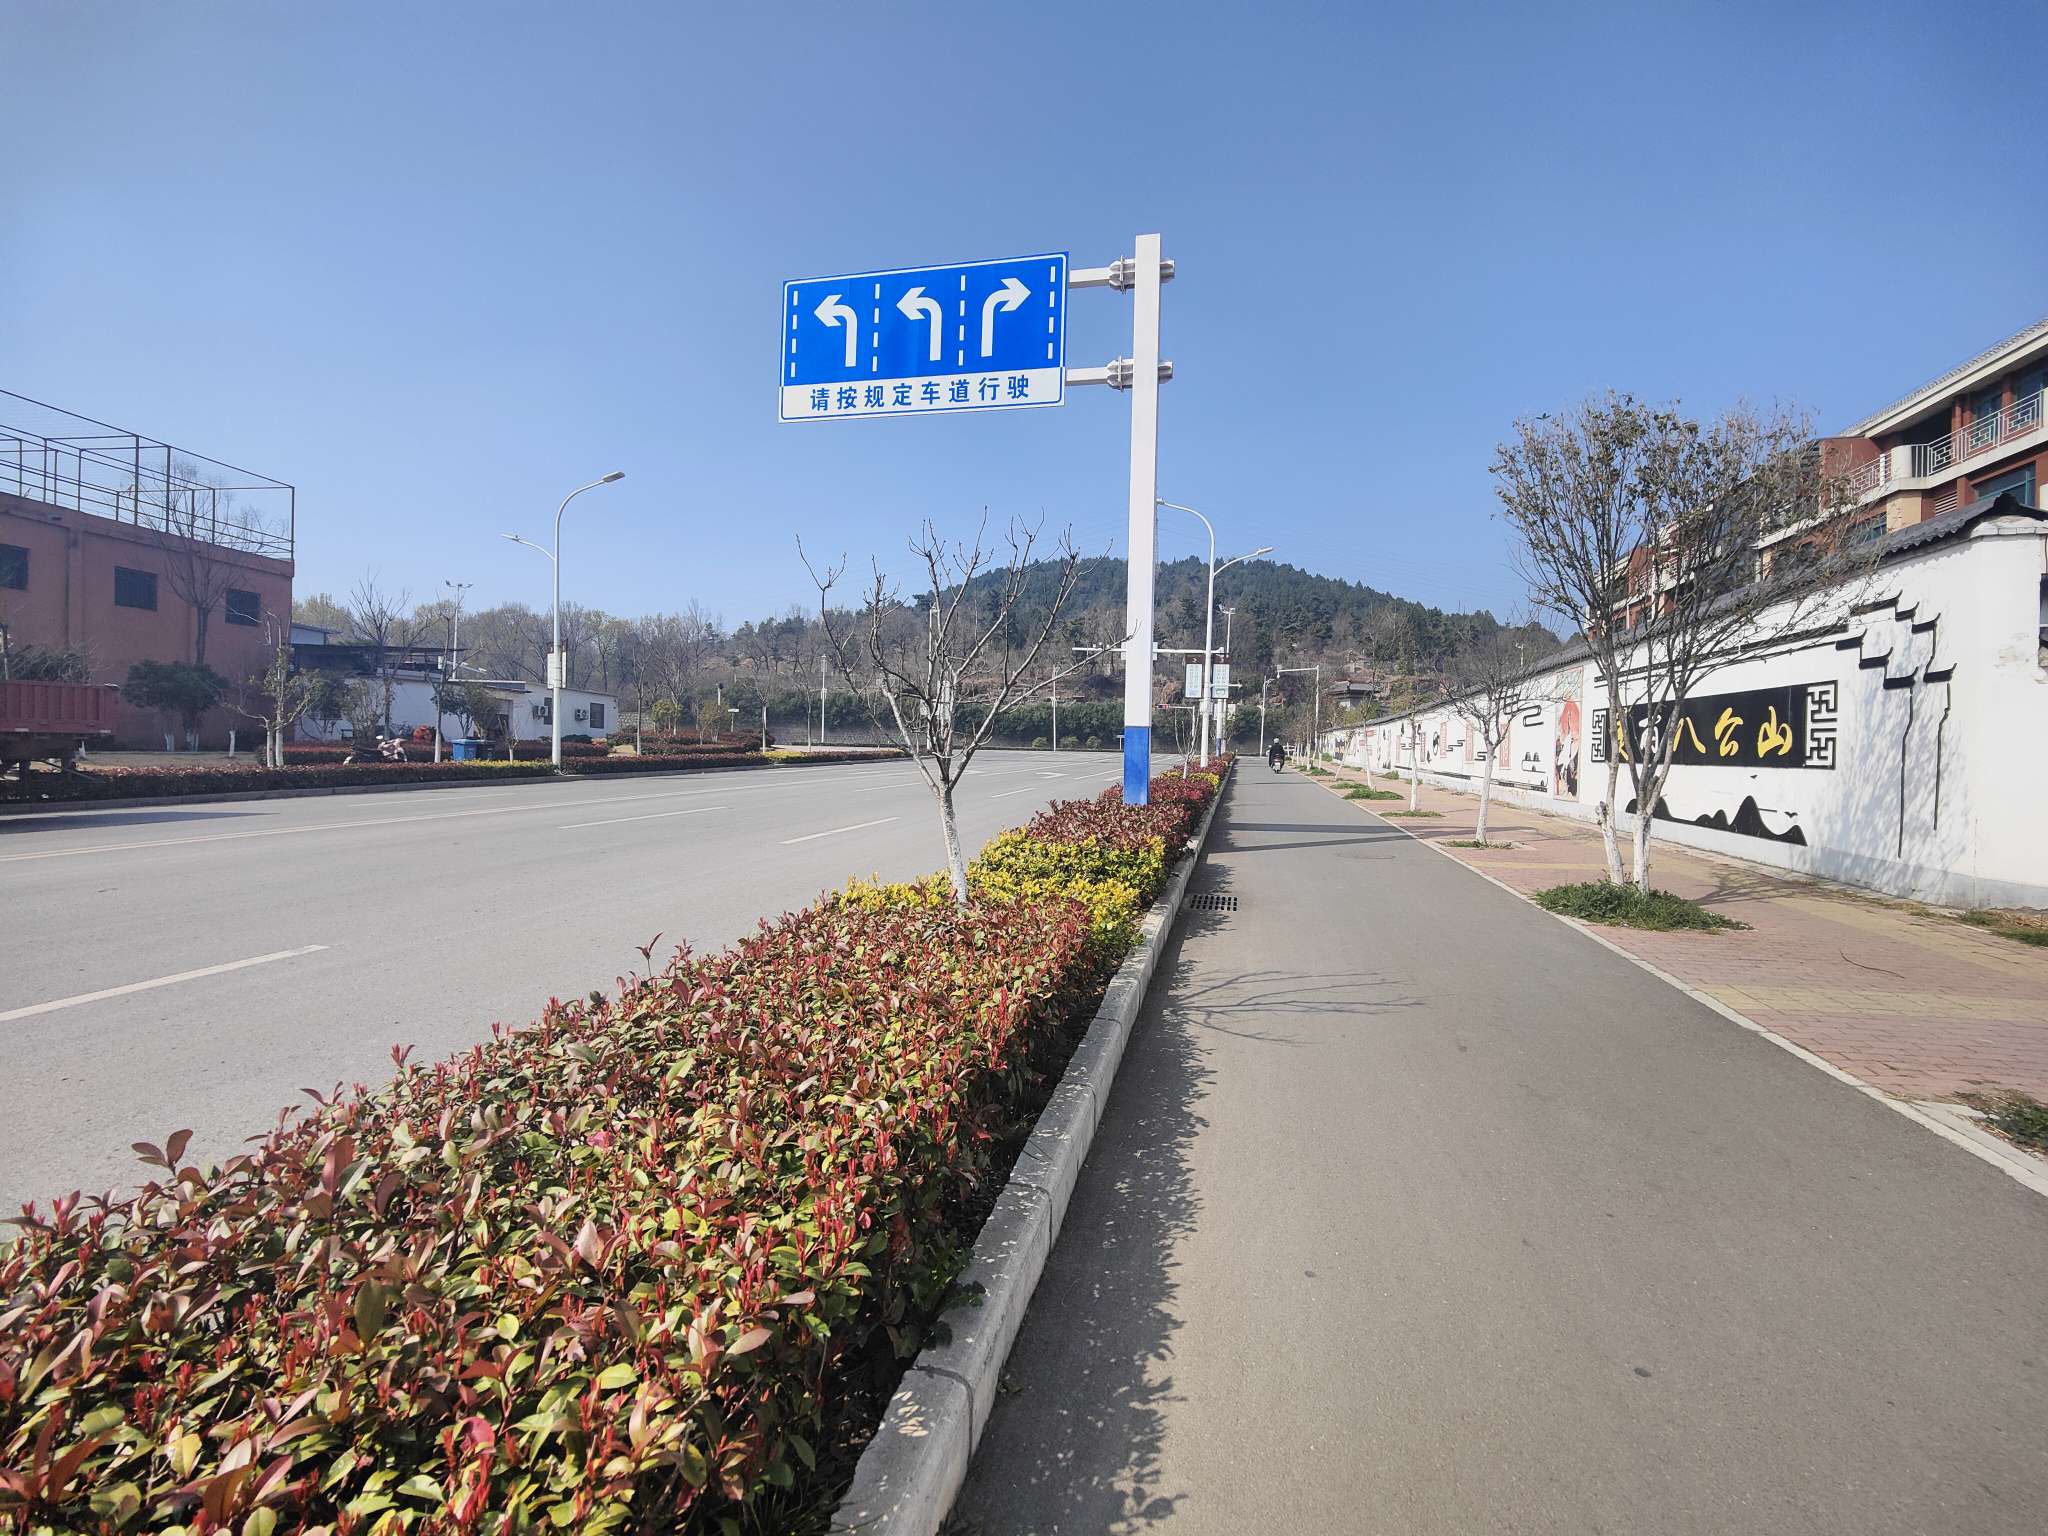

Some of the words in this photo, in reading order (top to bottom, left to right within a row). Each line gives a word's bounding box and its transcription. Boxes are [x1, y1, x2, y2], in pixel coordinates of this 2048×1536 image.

[810, 374, 1029, 411] 请按规定车道行驶
